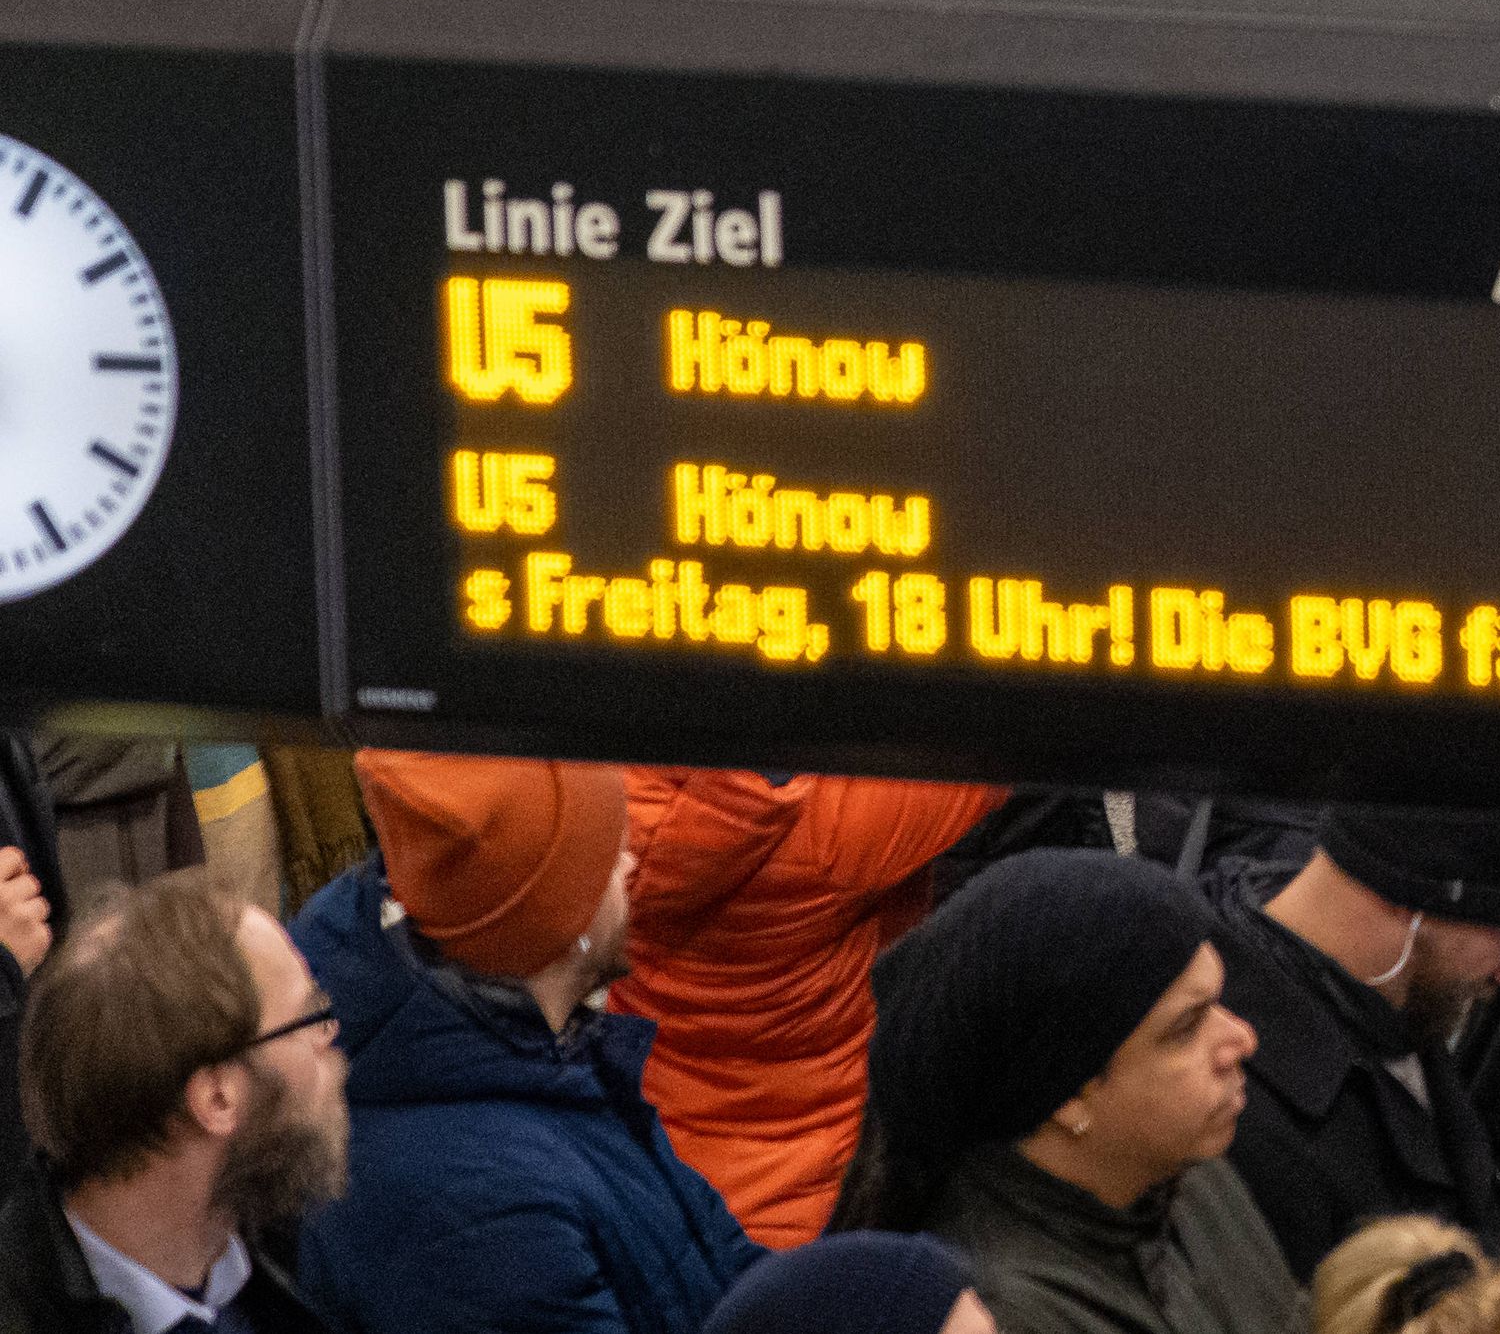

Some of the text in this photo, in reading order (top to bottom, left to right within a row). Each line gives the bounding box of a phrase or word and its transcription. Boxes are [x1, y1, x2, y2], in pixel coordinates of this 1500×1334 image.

[442, 178, 622, 259] Linie
[646, 187, 785, 268] Ziel
[443, 275, 929, 407] U5 Hönow
[452, 450, 558, 537] U5
[674, 462, 934, 558] Hönow
[526, 551, 831, 662] Freitag,
[853, 571, 948, 657] 18
[970, 577, 1136, 667] Uhr!
[1150, 586, 1276, 675] Die
[1290, 594, 1444, 684] BVG
